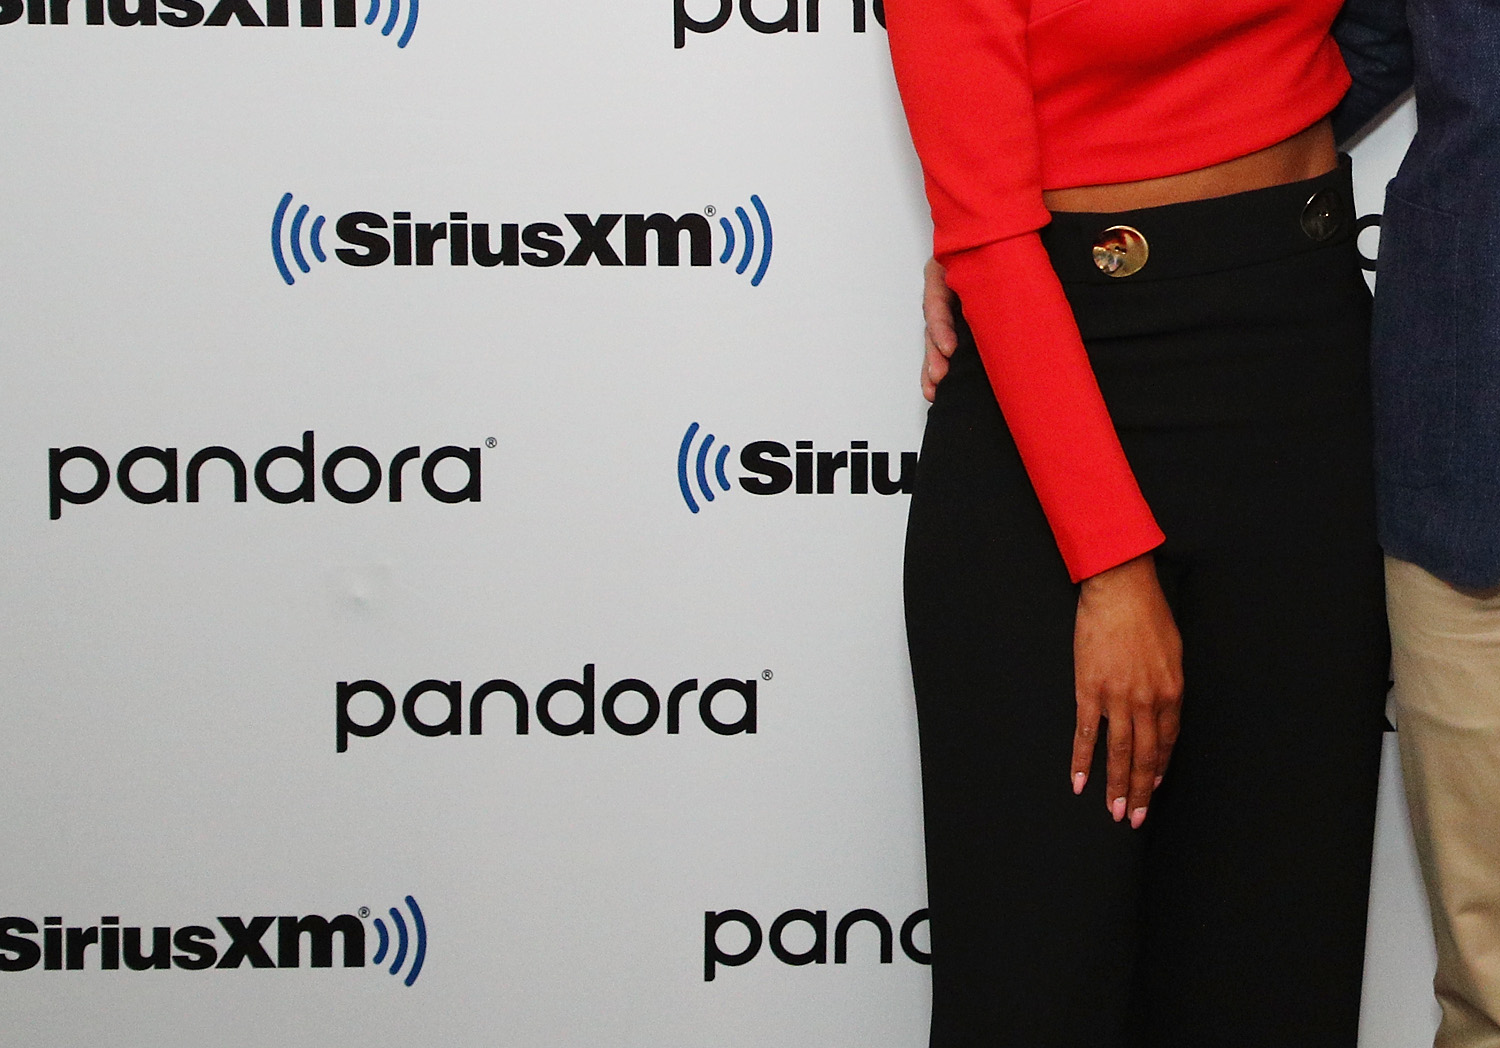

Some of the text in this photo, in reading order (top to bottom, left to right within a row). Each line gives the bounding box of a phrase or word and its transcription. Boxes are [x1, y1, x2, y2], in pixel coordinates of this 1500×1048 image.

[49, 431, 481, 520] pandora
[739, 441, 918, 496] Siriu
[336, 664, 757, 753] pandora
